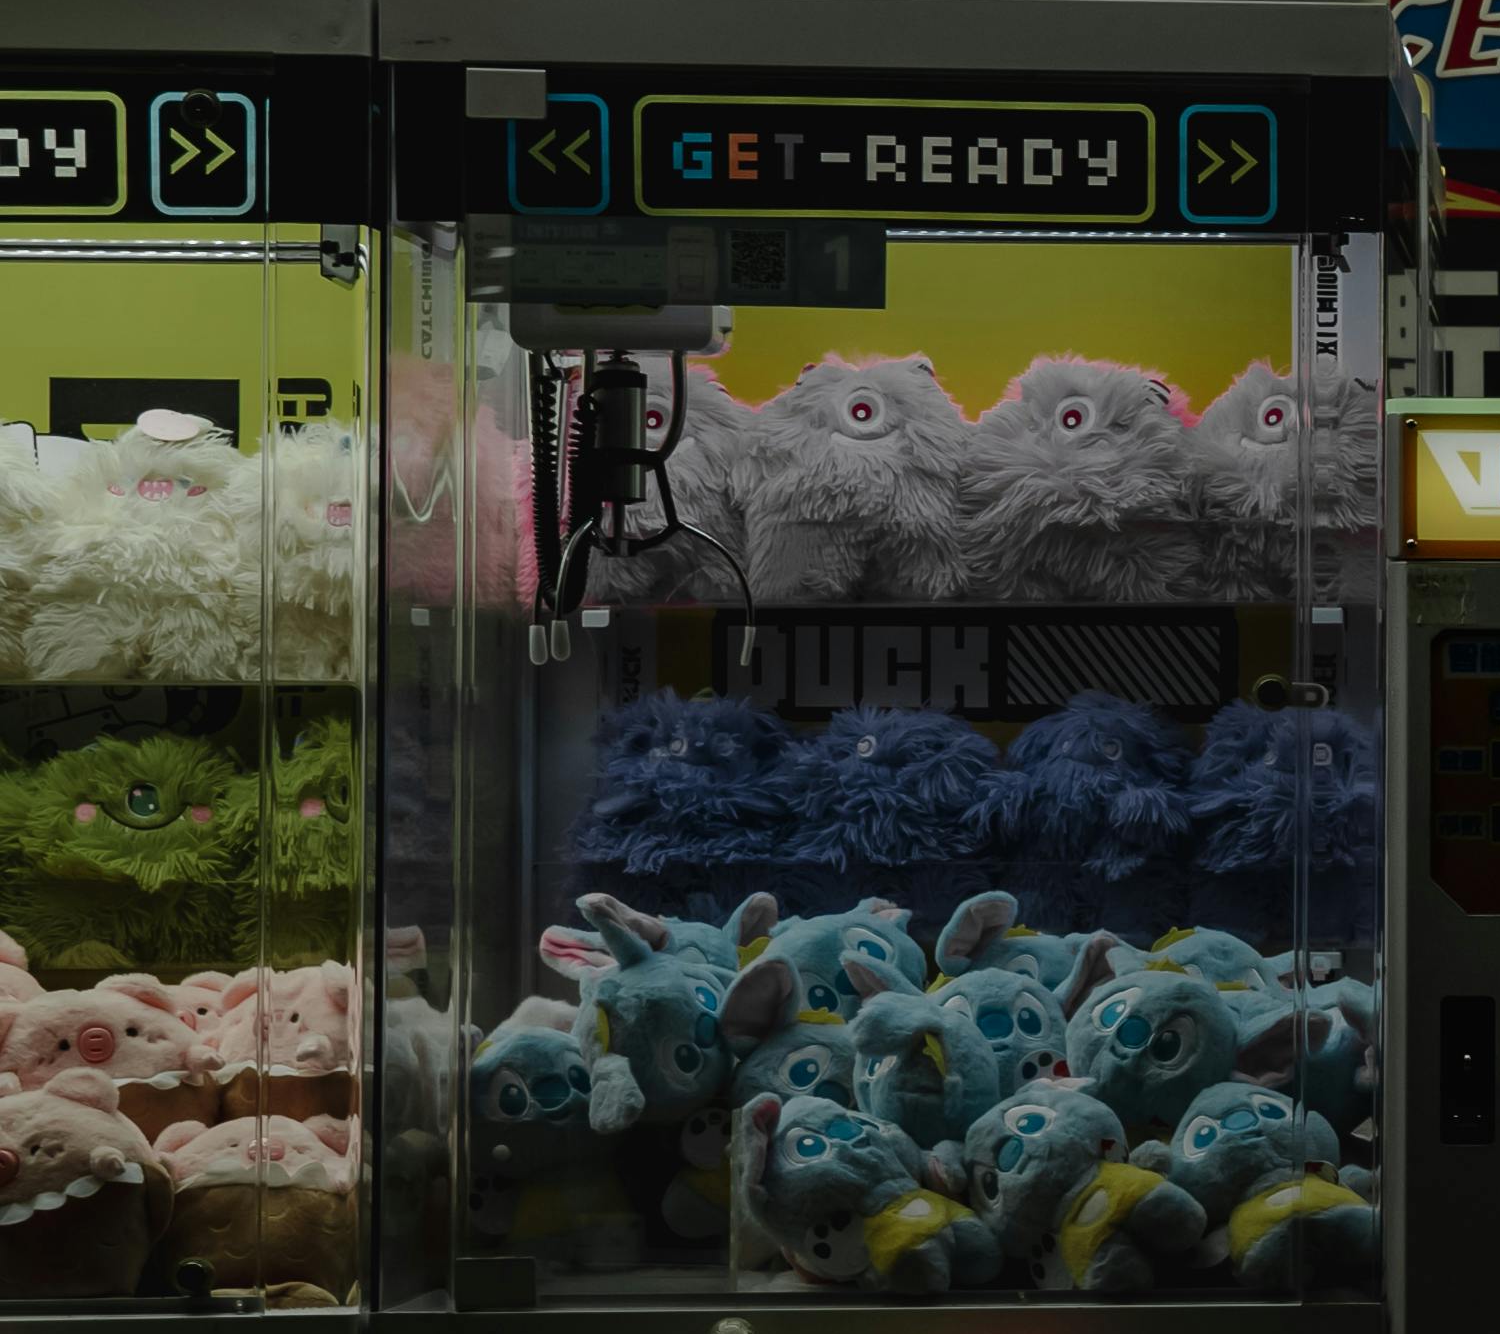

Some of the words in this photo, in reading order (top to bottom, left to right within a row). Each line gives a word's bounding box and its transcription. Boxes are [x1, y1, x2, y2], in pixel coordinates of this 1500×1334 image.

[672, 131, 1120, 188] GET-READY
[822, 234, 853, 292] 1
[724, 622, 992, 709] DUCK
